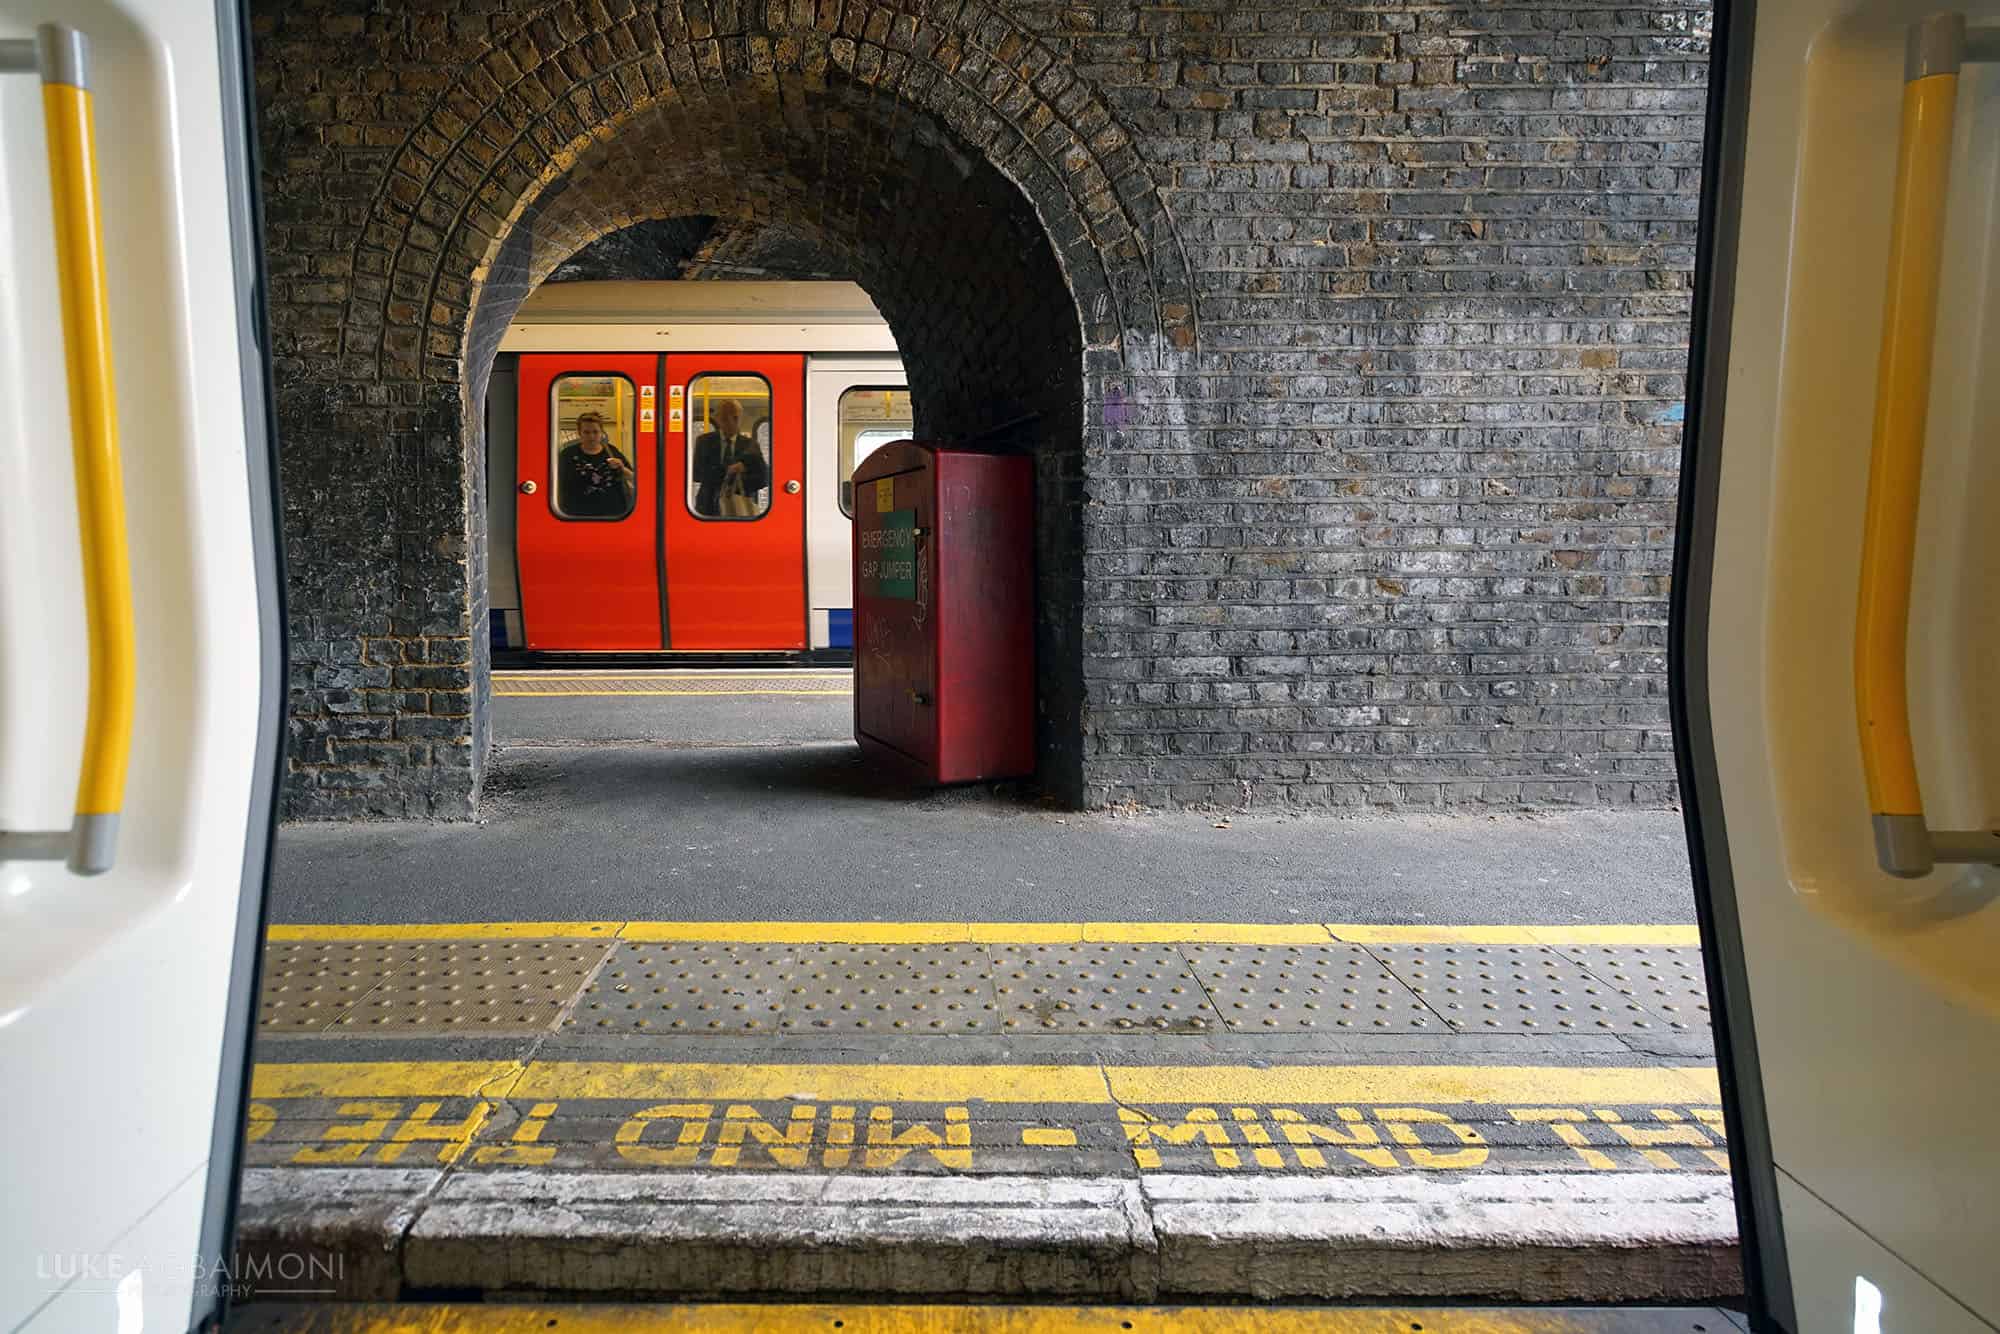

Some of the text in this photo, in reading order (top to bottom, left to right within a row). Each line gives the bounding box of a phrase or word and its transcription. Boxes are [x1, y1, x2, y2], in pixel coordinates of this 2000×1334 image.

[863, 560, 879, 578] GAP
[292, 1101, 558, 1165] THE
[615, 1102, 974, 1168] MIND
[1117, 1107, 1491, 1168] MIND
